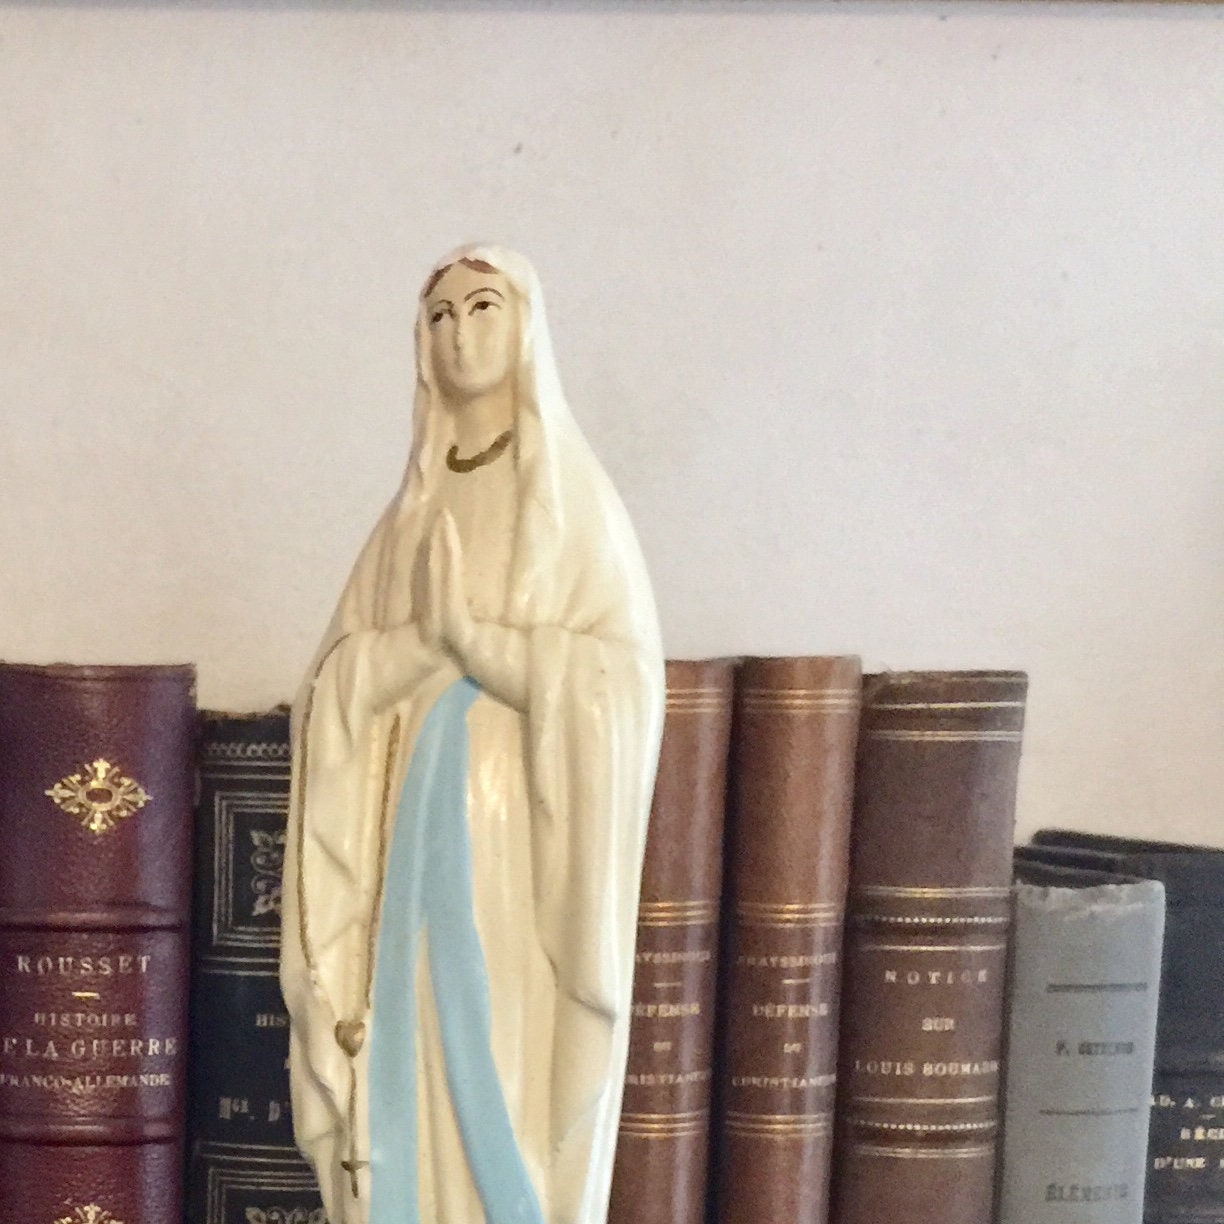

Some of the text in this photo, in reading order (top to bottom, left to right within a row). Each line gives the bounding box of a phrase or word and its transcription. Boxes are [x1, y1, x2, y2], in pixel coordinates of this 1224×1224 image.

[16, 955, 151, 976] ROUSSET
[884, 968, 989, 986] NOTICE
[34, 1012, 137, 1027] HISTOIRE
[921, 1017, 956, 1032] SUR
[25, 1038, 58, 1058] LA
[70, 1037, 177, 1059] GUERRE
[855, 1059, 915, 1077] LOUIS
